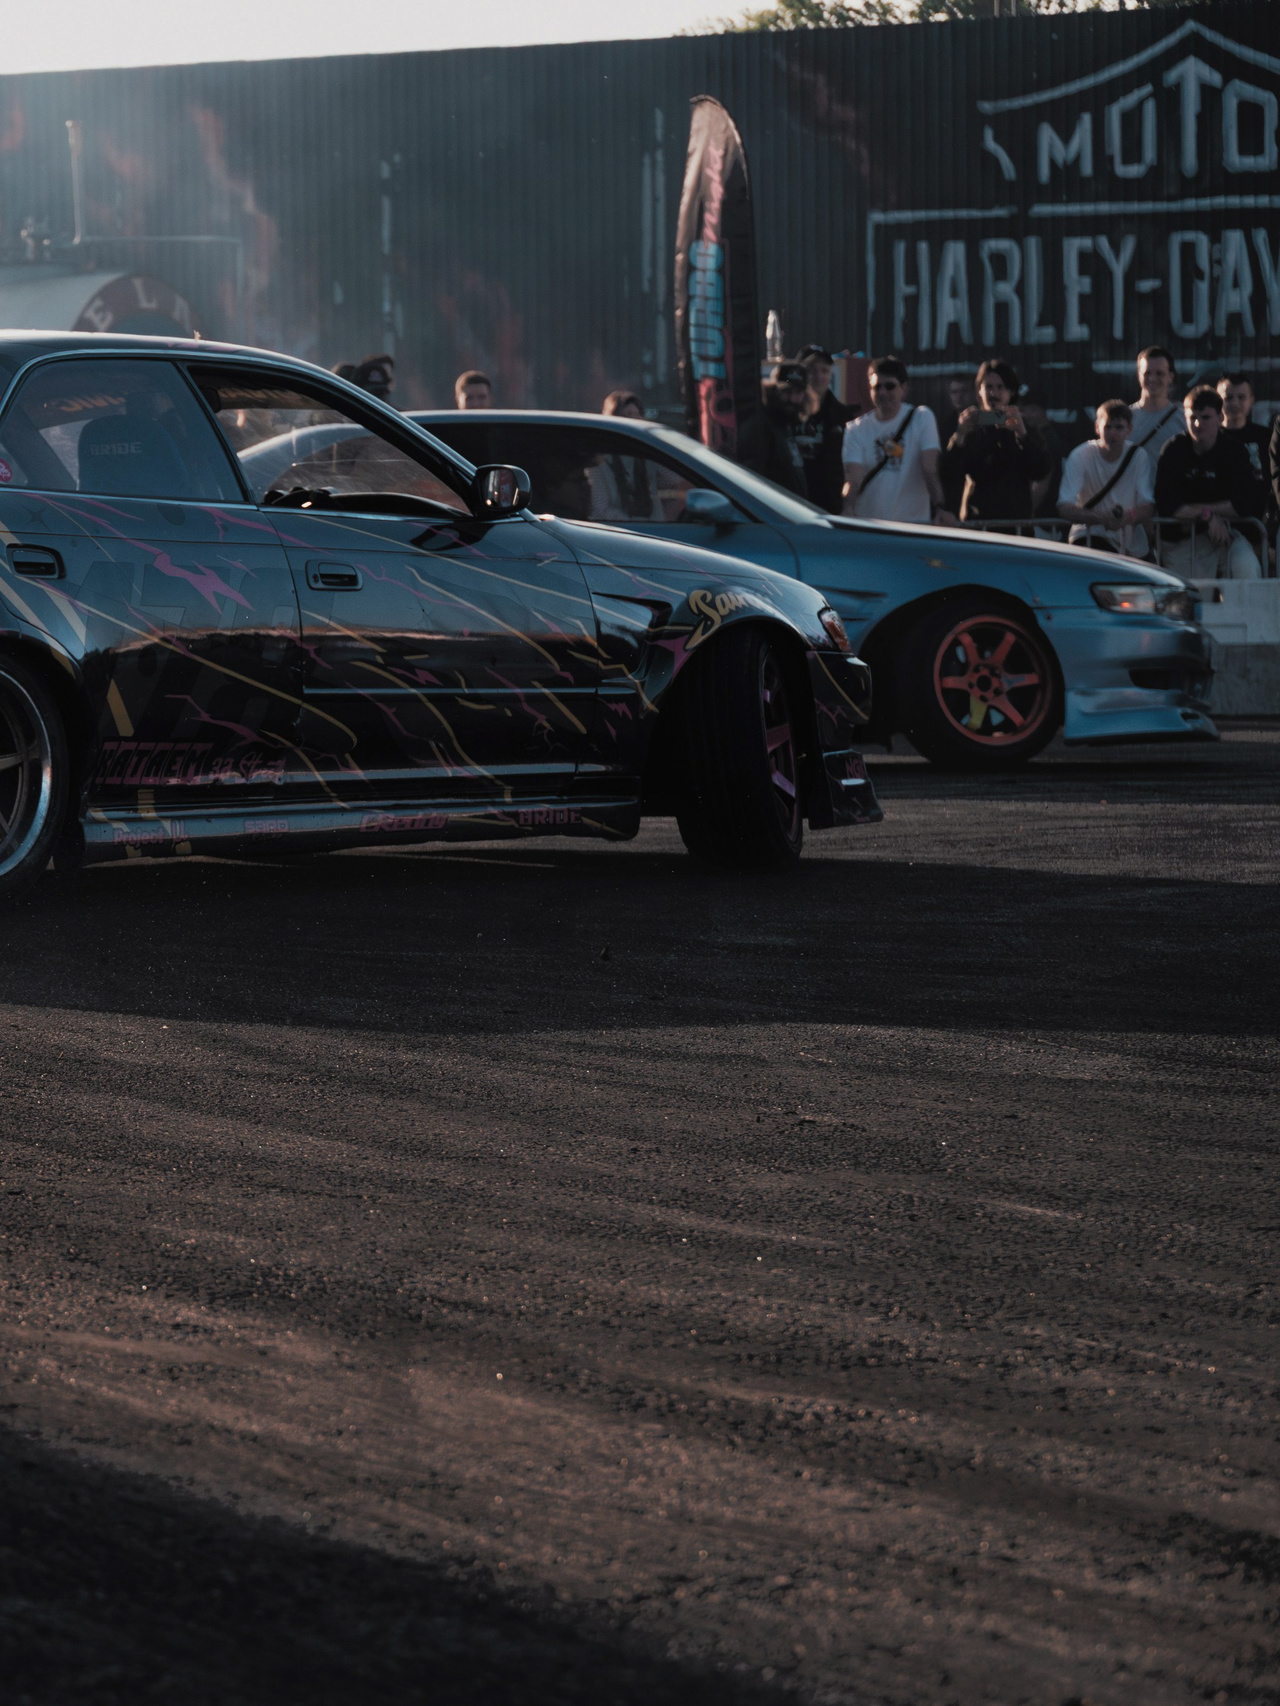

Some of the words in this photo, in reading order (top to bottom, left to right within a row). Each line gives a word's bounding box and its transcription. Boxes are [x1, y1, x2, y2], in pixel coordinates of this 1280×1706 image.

[687, 239, 728, 382] TURBO
[518, 807, 583, 826] BRIDE
[112, 827, 165, 849] Project
